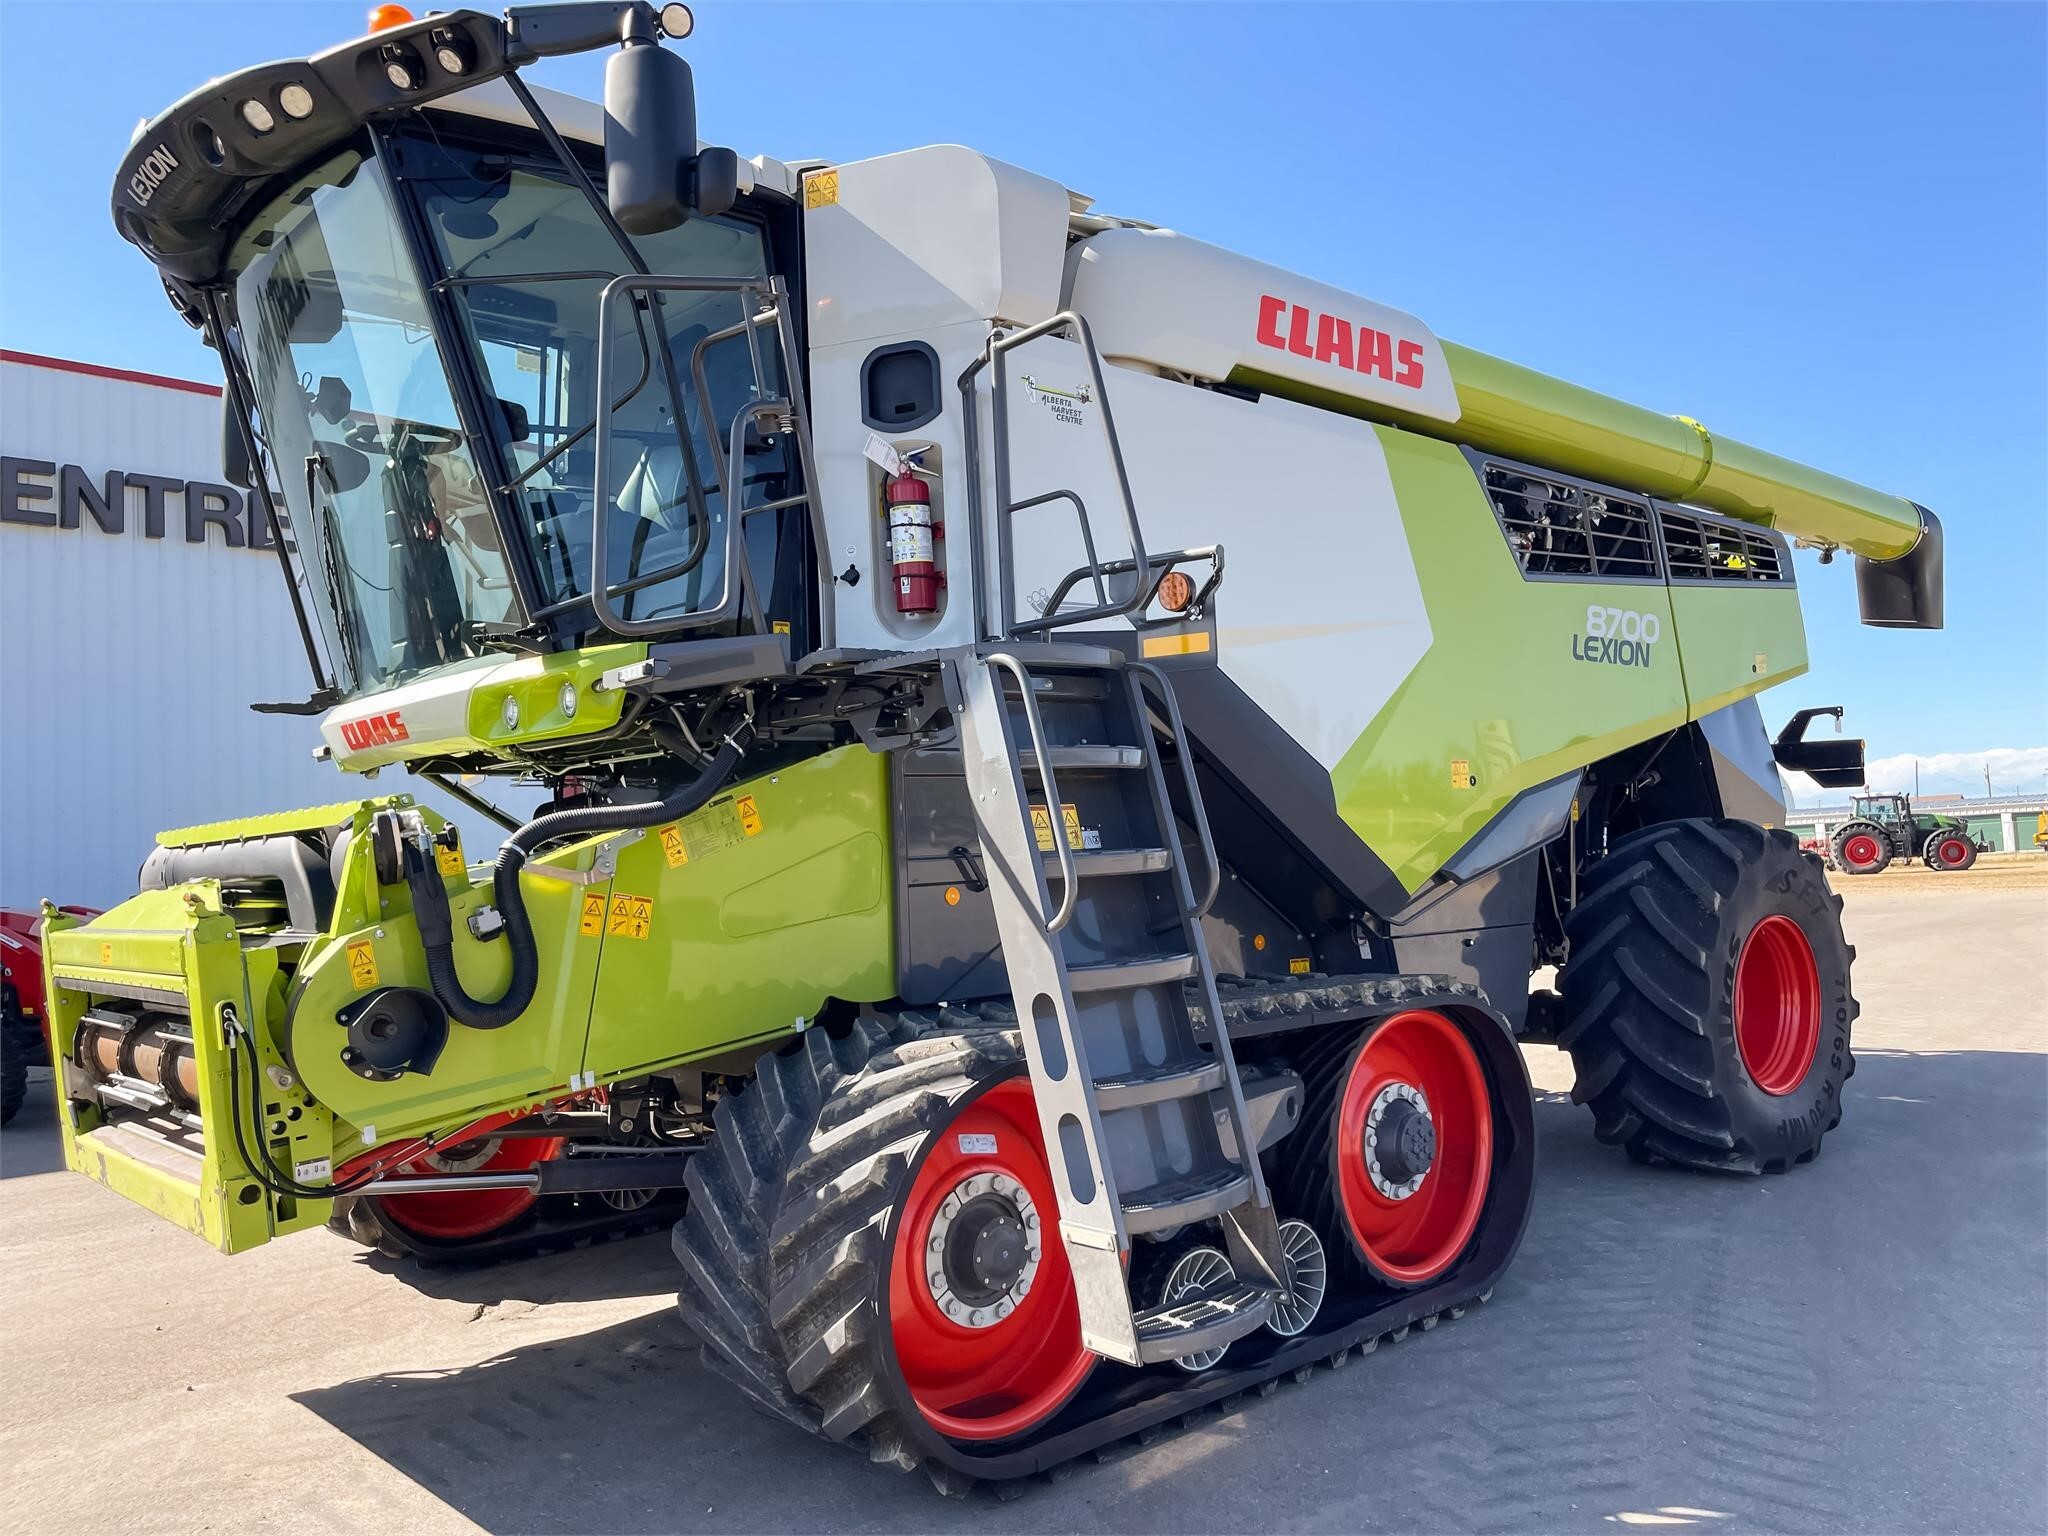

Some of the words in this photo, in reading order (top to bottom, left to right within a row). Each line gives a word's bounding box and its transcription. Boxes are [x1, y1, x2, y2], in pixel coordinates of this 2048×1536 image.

[126, 144, 179, 207] LEXION
[1256, 294, 1424, 390] CLAAS
[1041, 394, 1073, 408] ALBERTA
[1051, 404, 1083, 418] HARVEST
[1056, 413, 1084, 426] CENTRE
[1586, 604, 1661, 644] 8700
[1572, 633, 1651, 668] LEXION
[340, 710, 410, 751] CLAAS
[1831, 973, 1848, 1072] 710/65
